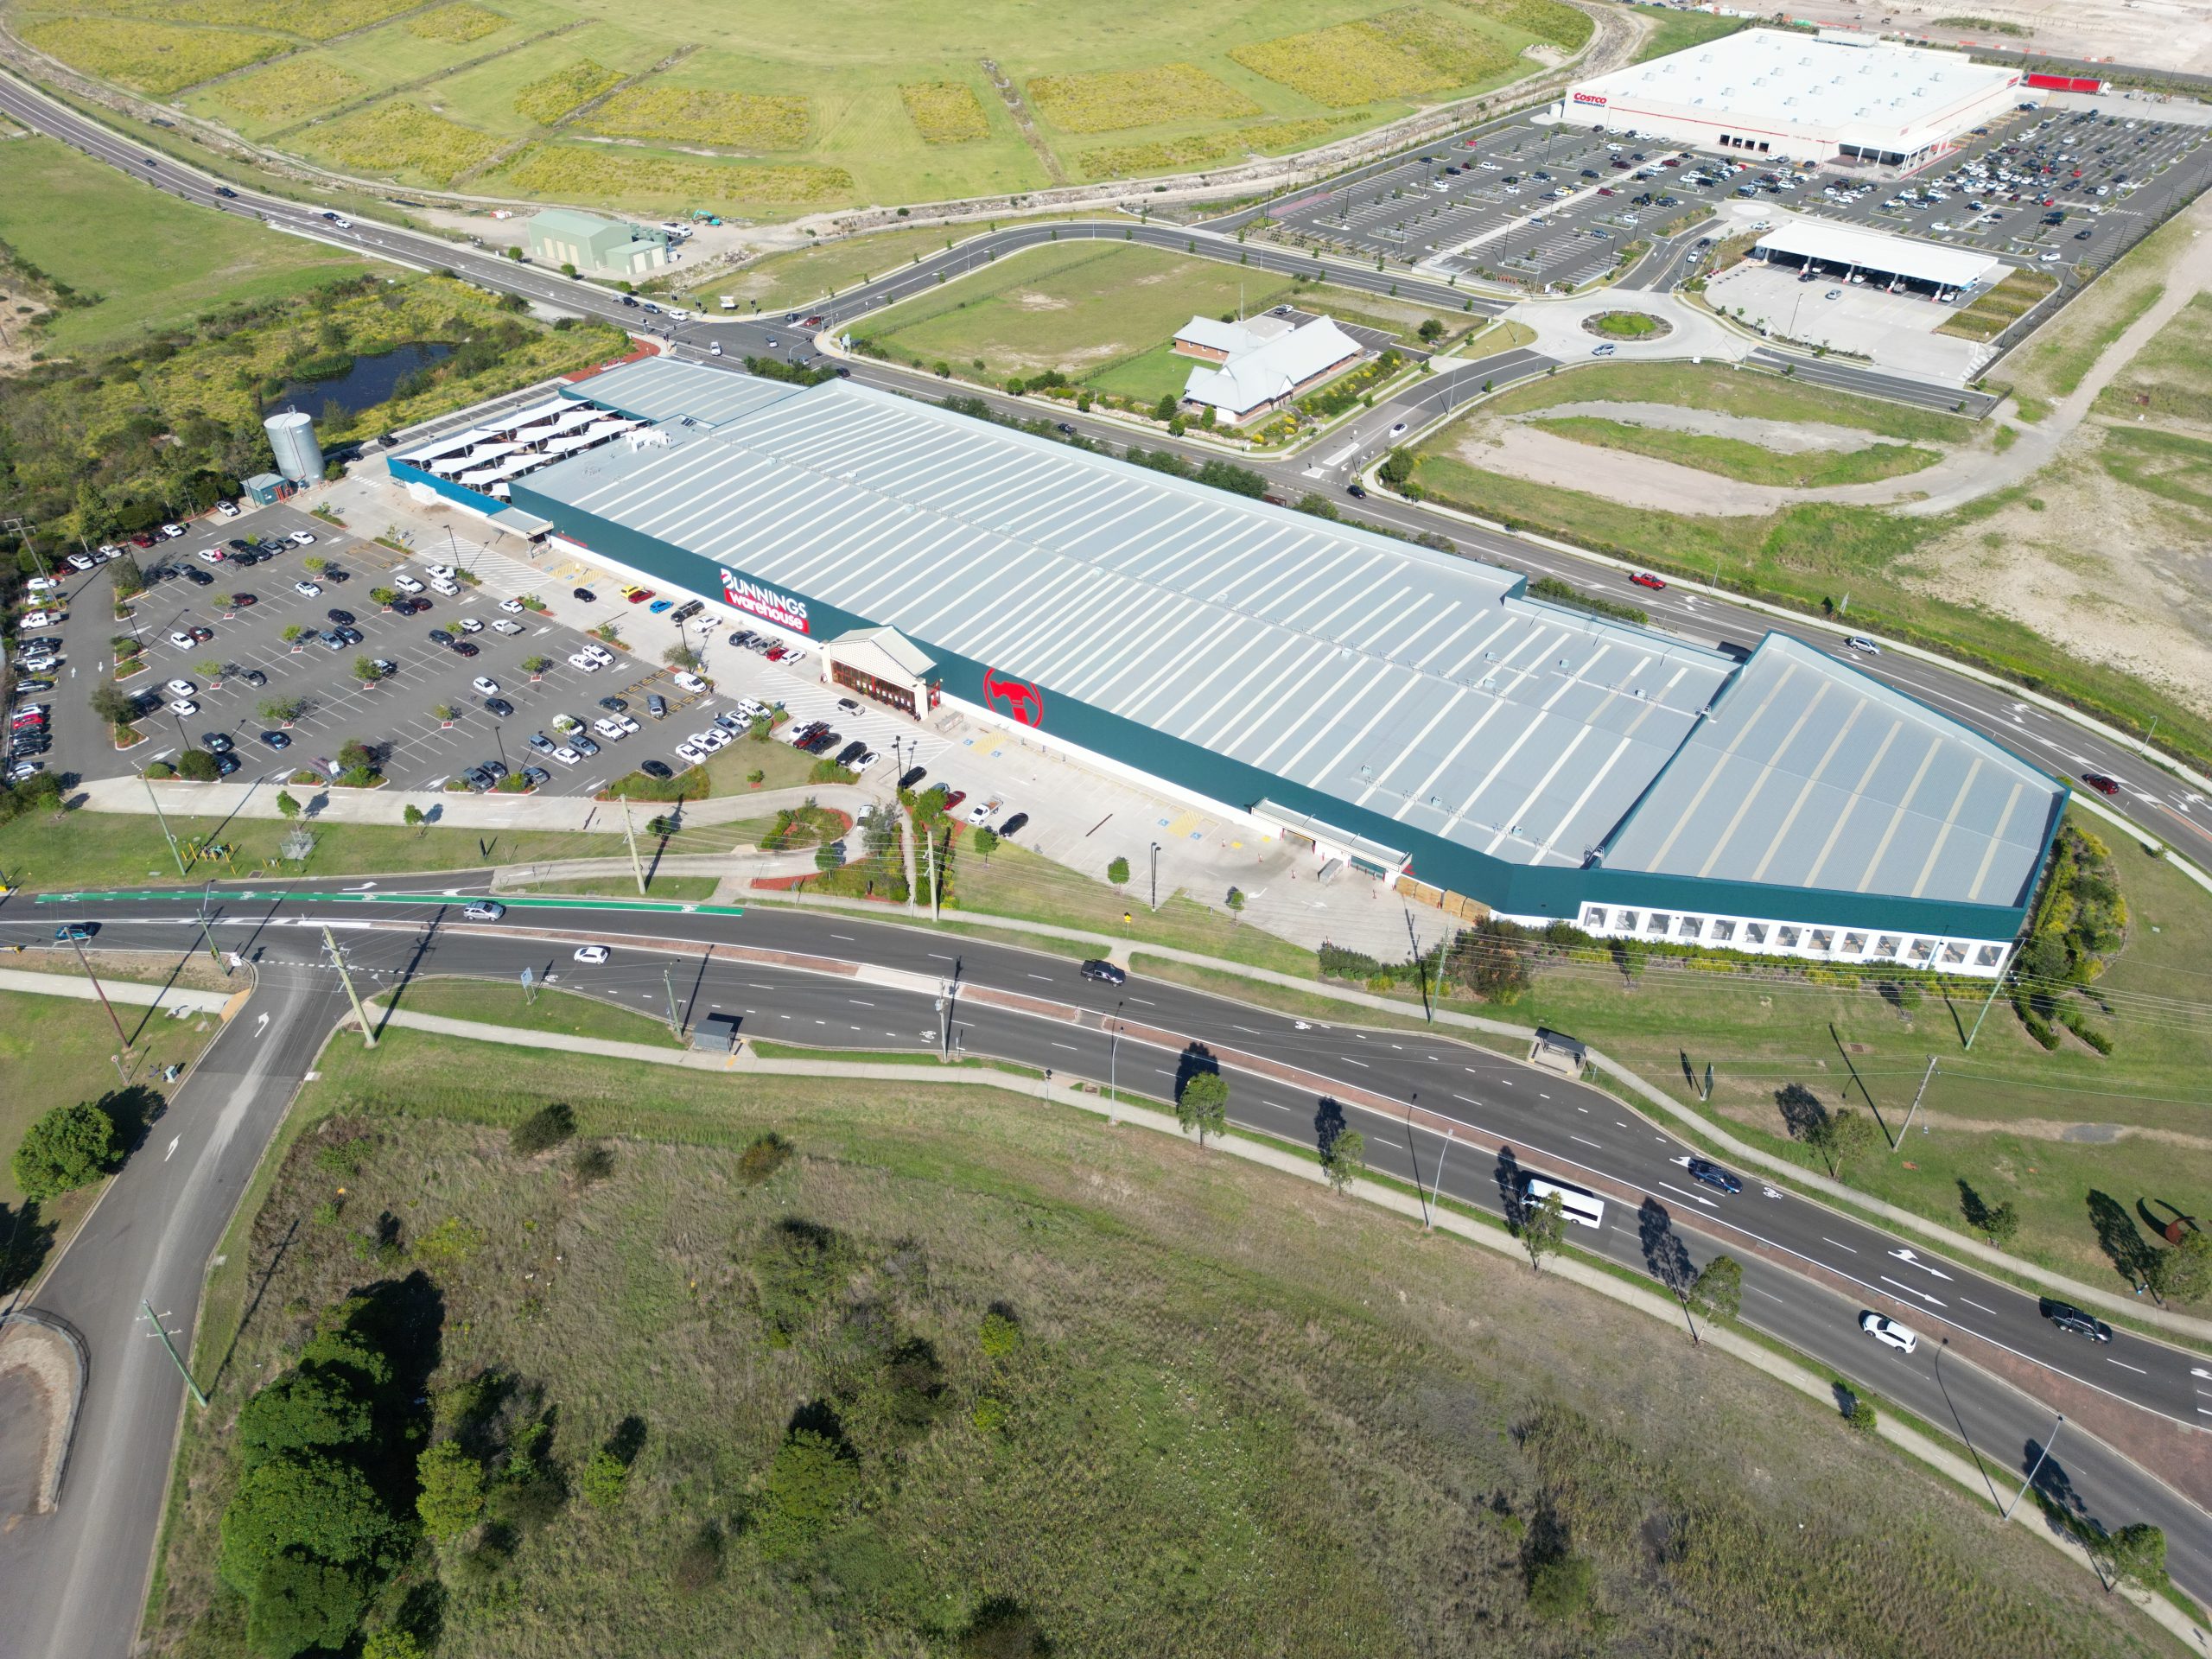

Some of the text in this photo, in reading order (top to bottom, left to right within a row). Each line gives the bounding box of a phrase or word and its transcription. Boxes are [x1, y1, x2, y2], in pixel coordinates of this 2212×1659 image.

[1573, 92, 1607, 104] COSTCO
[721, 568, 807, 619] BUNNINGS
[729, 591, 804, 630] warehouse
